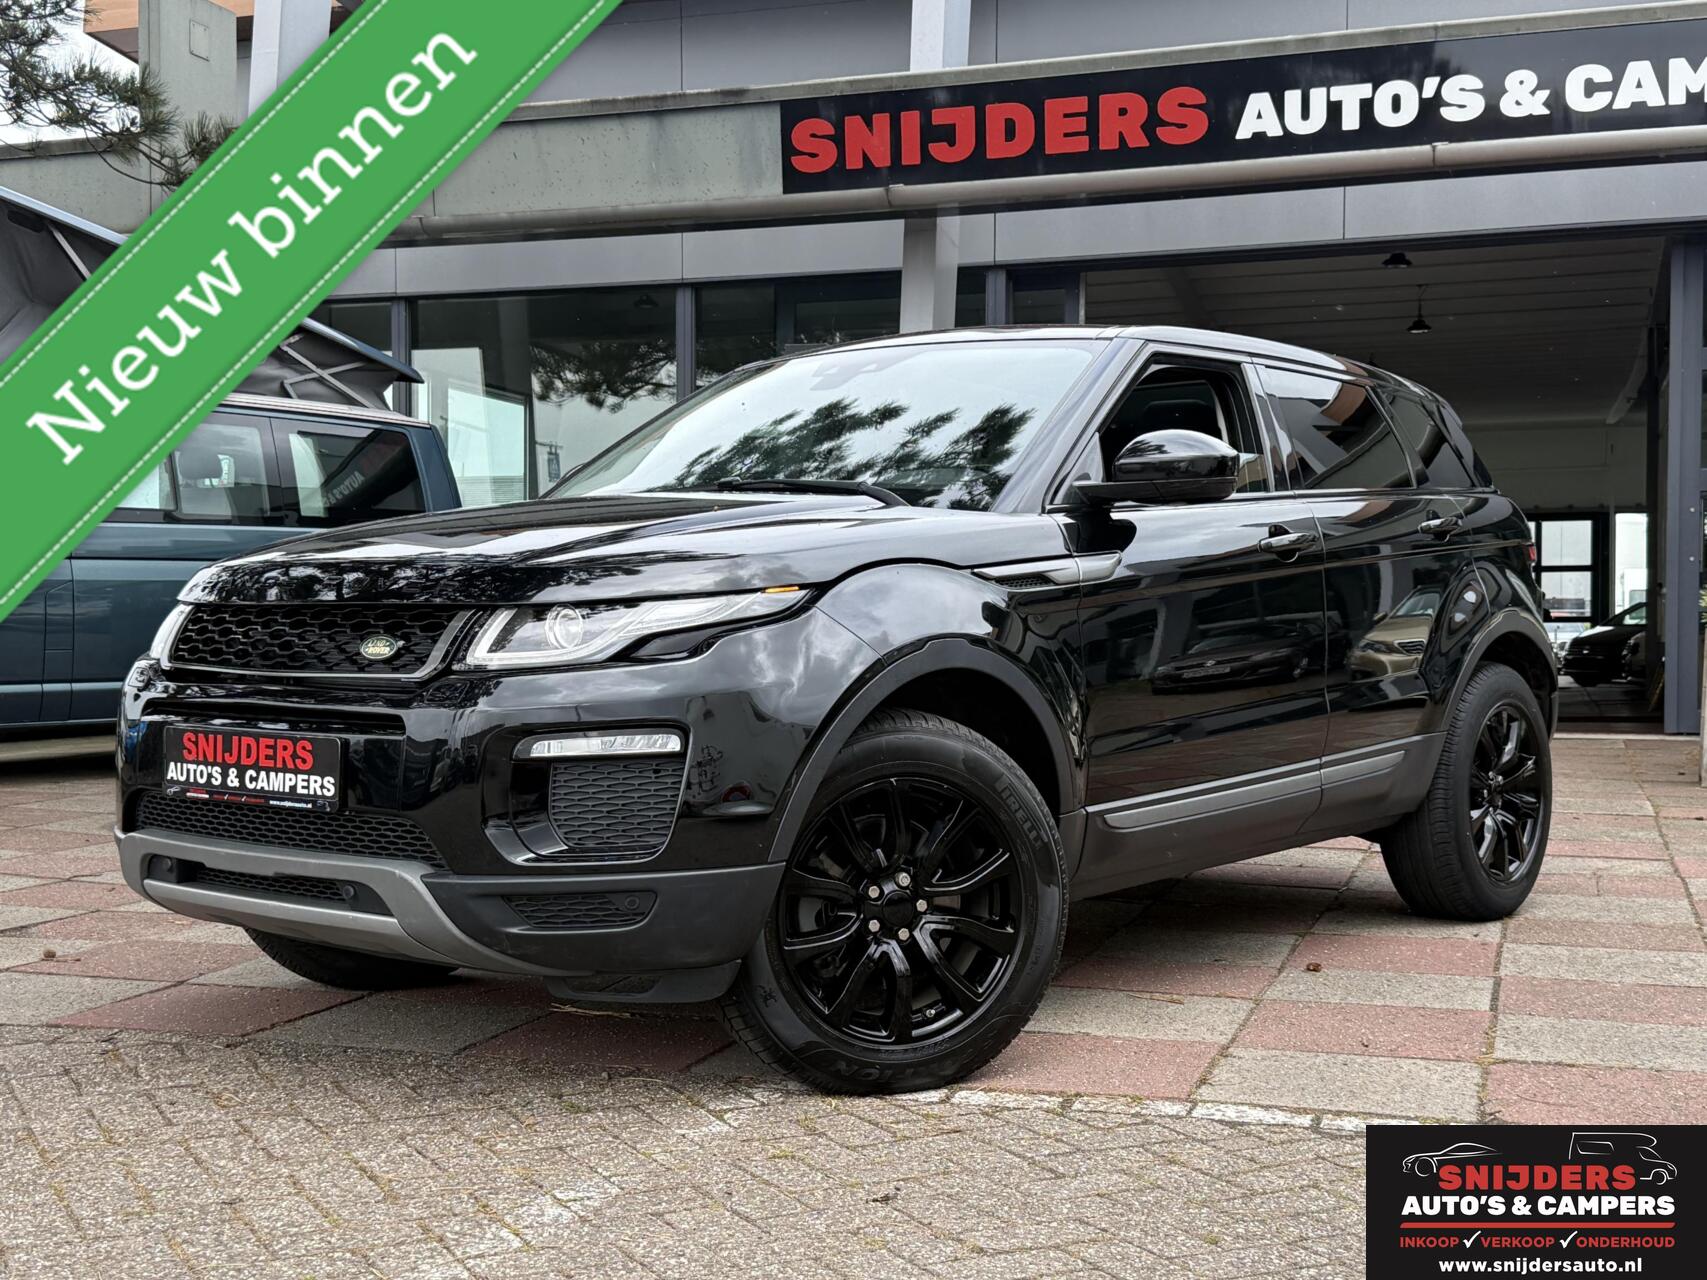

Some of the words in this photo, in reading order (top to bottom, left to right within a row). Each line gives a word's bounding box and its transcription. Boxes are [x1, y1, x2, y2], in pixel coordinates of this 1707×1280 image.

[791, 87, 1209, 173] SNIJDERS
[1236, 74, 1486, 140] AUTO'S
[1500, 69, 1550, 117] &
[183, 732, 314, 771] SNIJDERS
[167, 761, 222, 786] AUTO'S
[226, 767, 240, 787] &
[244, 771, 336, 797] CAMPERS
